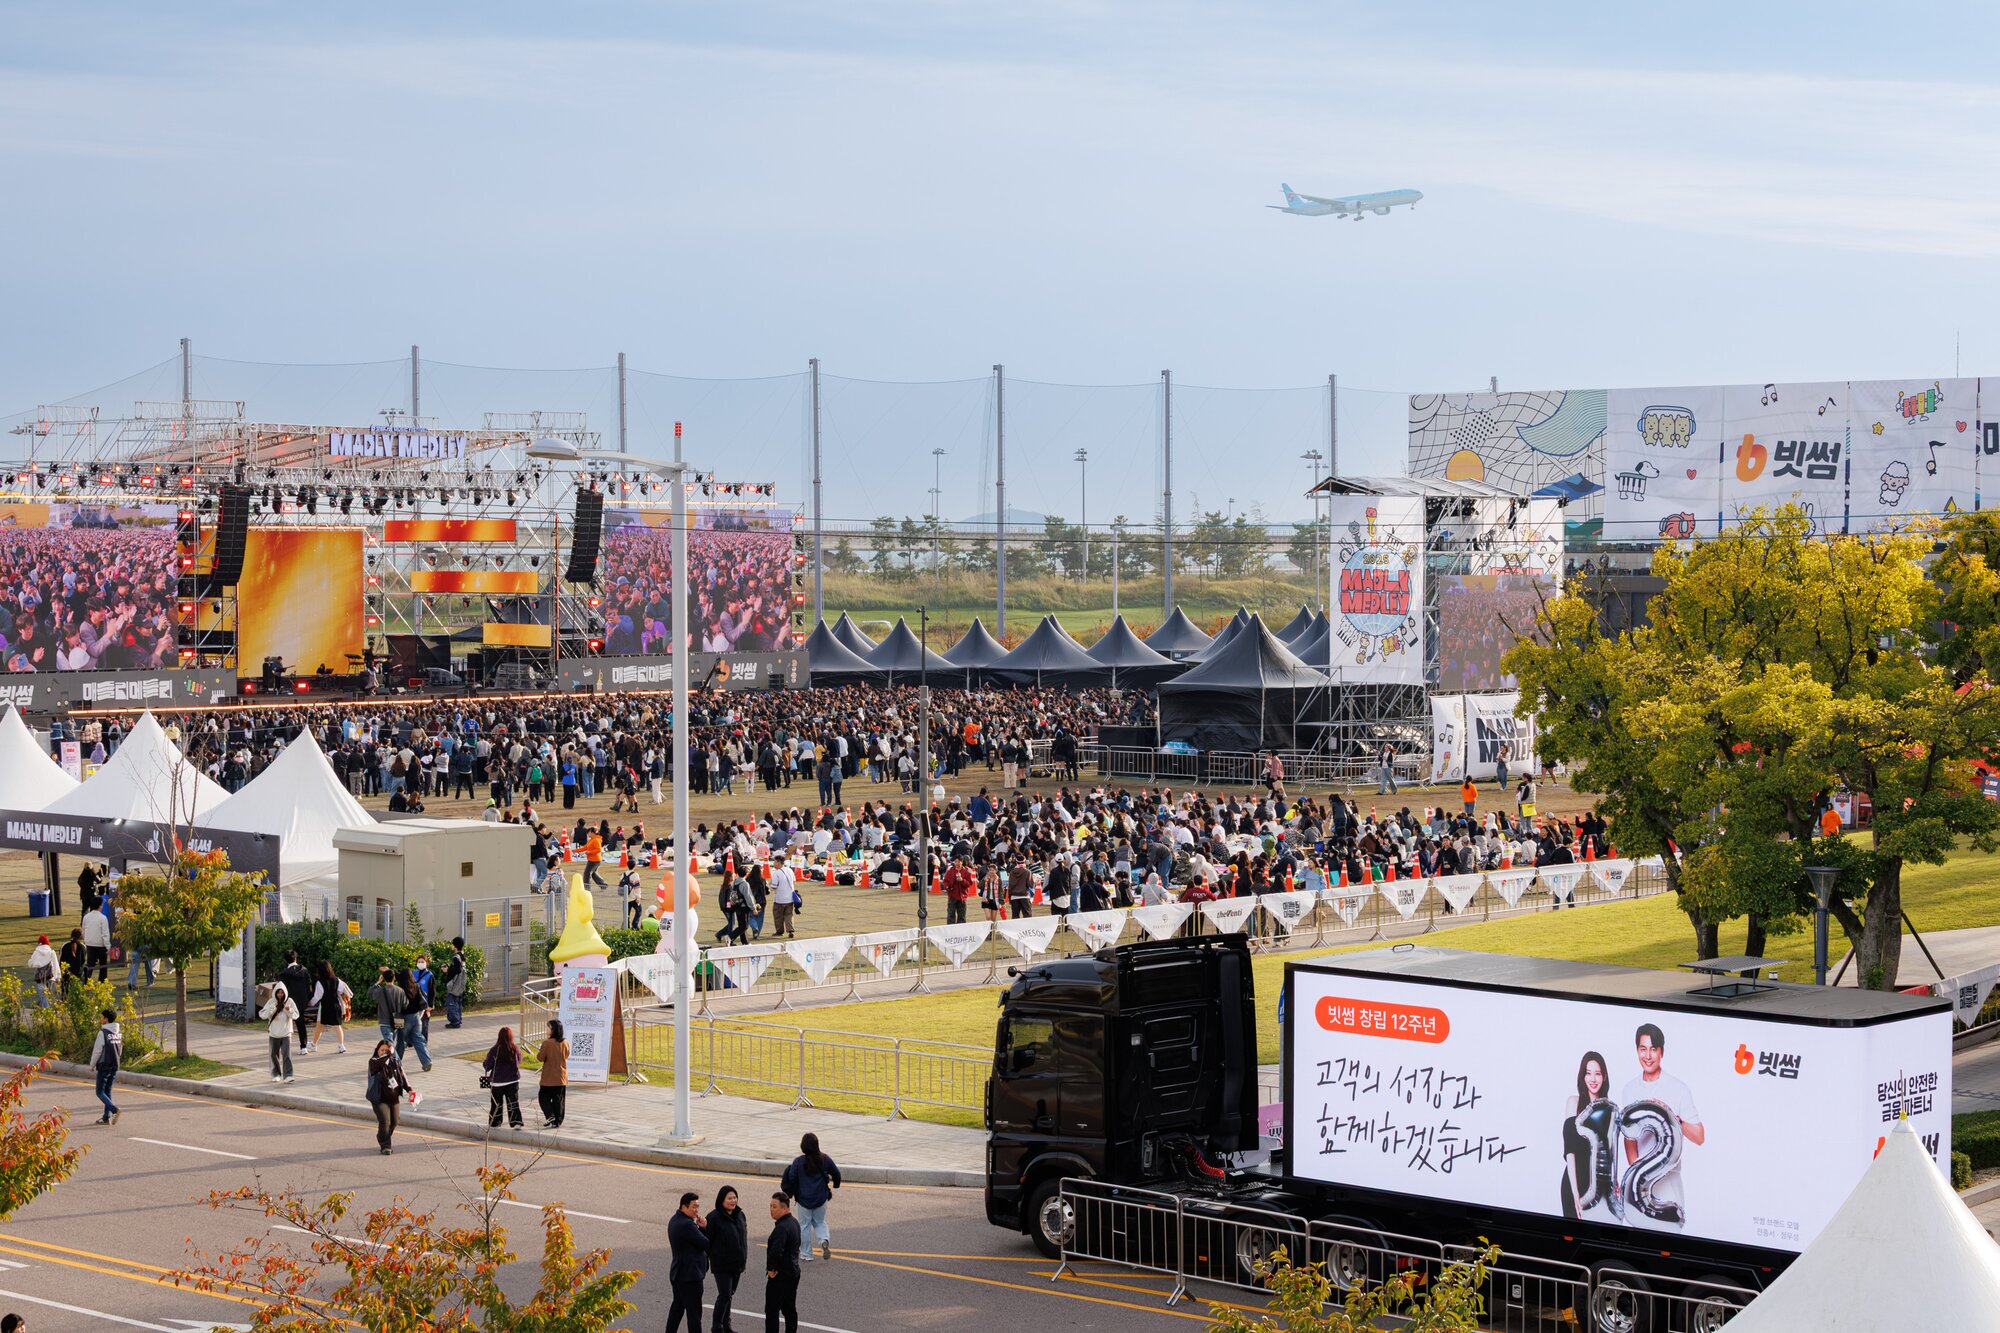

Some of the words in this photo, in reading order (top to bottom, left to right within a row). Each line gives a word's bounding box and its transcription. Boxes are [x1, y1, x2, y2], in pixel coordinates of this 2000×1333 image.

[330, 433, 394, 456] MADLY
[399, 435, 467, 458] MEDLEY
[1773, 441, 1842, 480] 빗썸
[1362, 554, 1389, 564] 2025
[1341, 569, 1410, 591] MADLY
[1341, 592, 1410, 615] MEDLEY
[732, 662, 757, 680] 빗썸
[1478, 739, 1531, 763] MDLEY
[7, 821, 42, 840] MADLY
[43, 825, 82, 844] MEDLEY
[1217, 909, 1242, 919] theVenti
[944, 936, 976, 944] MEDIHEAL
[1017, 930, 1046, 939] JAMESON
[1328, 1005, 1355, 1026] 빗썸
[1359, 1009, 1387, 1030] 창립
[1391, 1013, 1436, 1035] 12주년
[1758, 1051, 1801, 1079] 빗썸
[1316, 1057, 1379, 1101] 고객의
[1389, 1065, 1482, 1109] 성장과
[1877, 1078, 1907, 1102] 당신의
[1908, 1071, 1938, 1095] 안전한
[1882, 1100, 1901, 1122] 금융
[1902, 1093, 1932, 1116] 파트너
[1316, 1102, 1527, 1174] 함께하겠습니다
[1767, 1218, 1785, 1228] 브랜드
